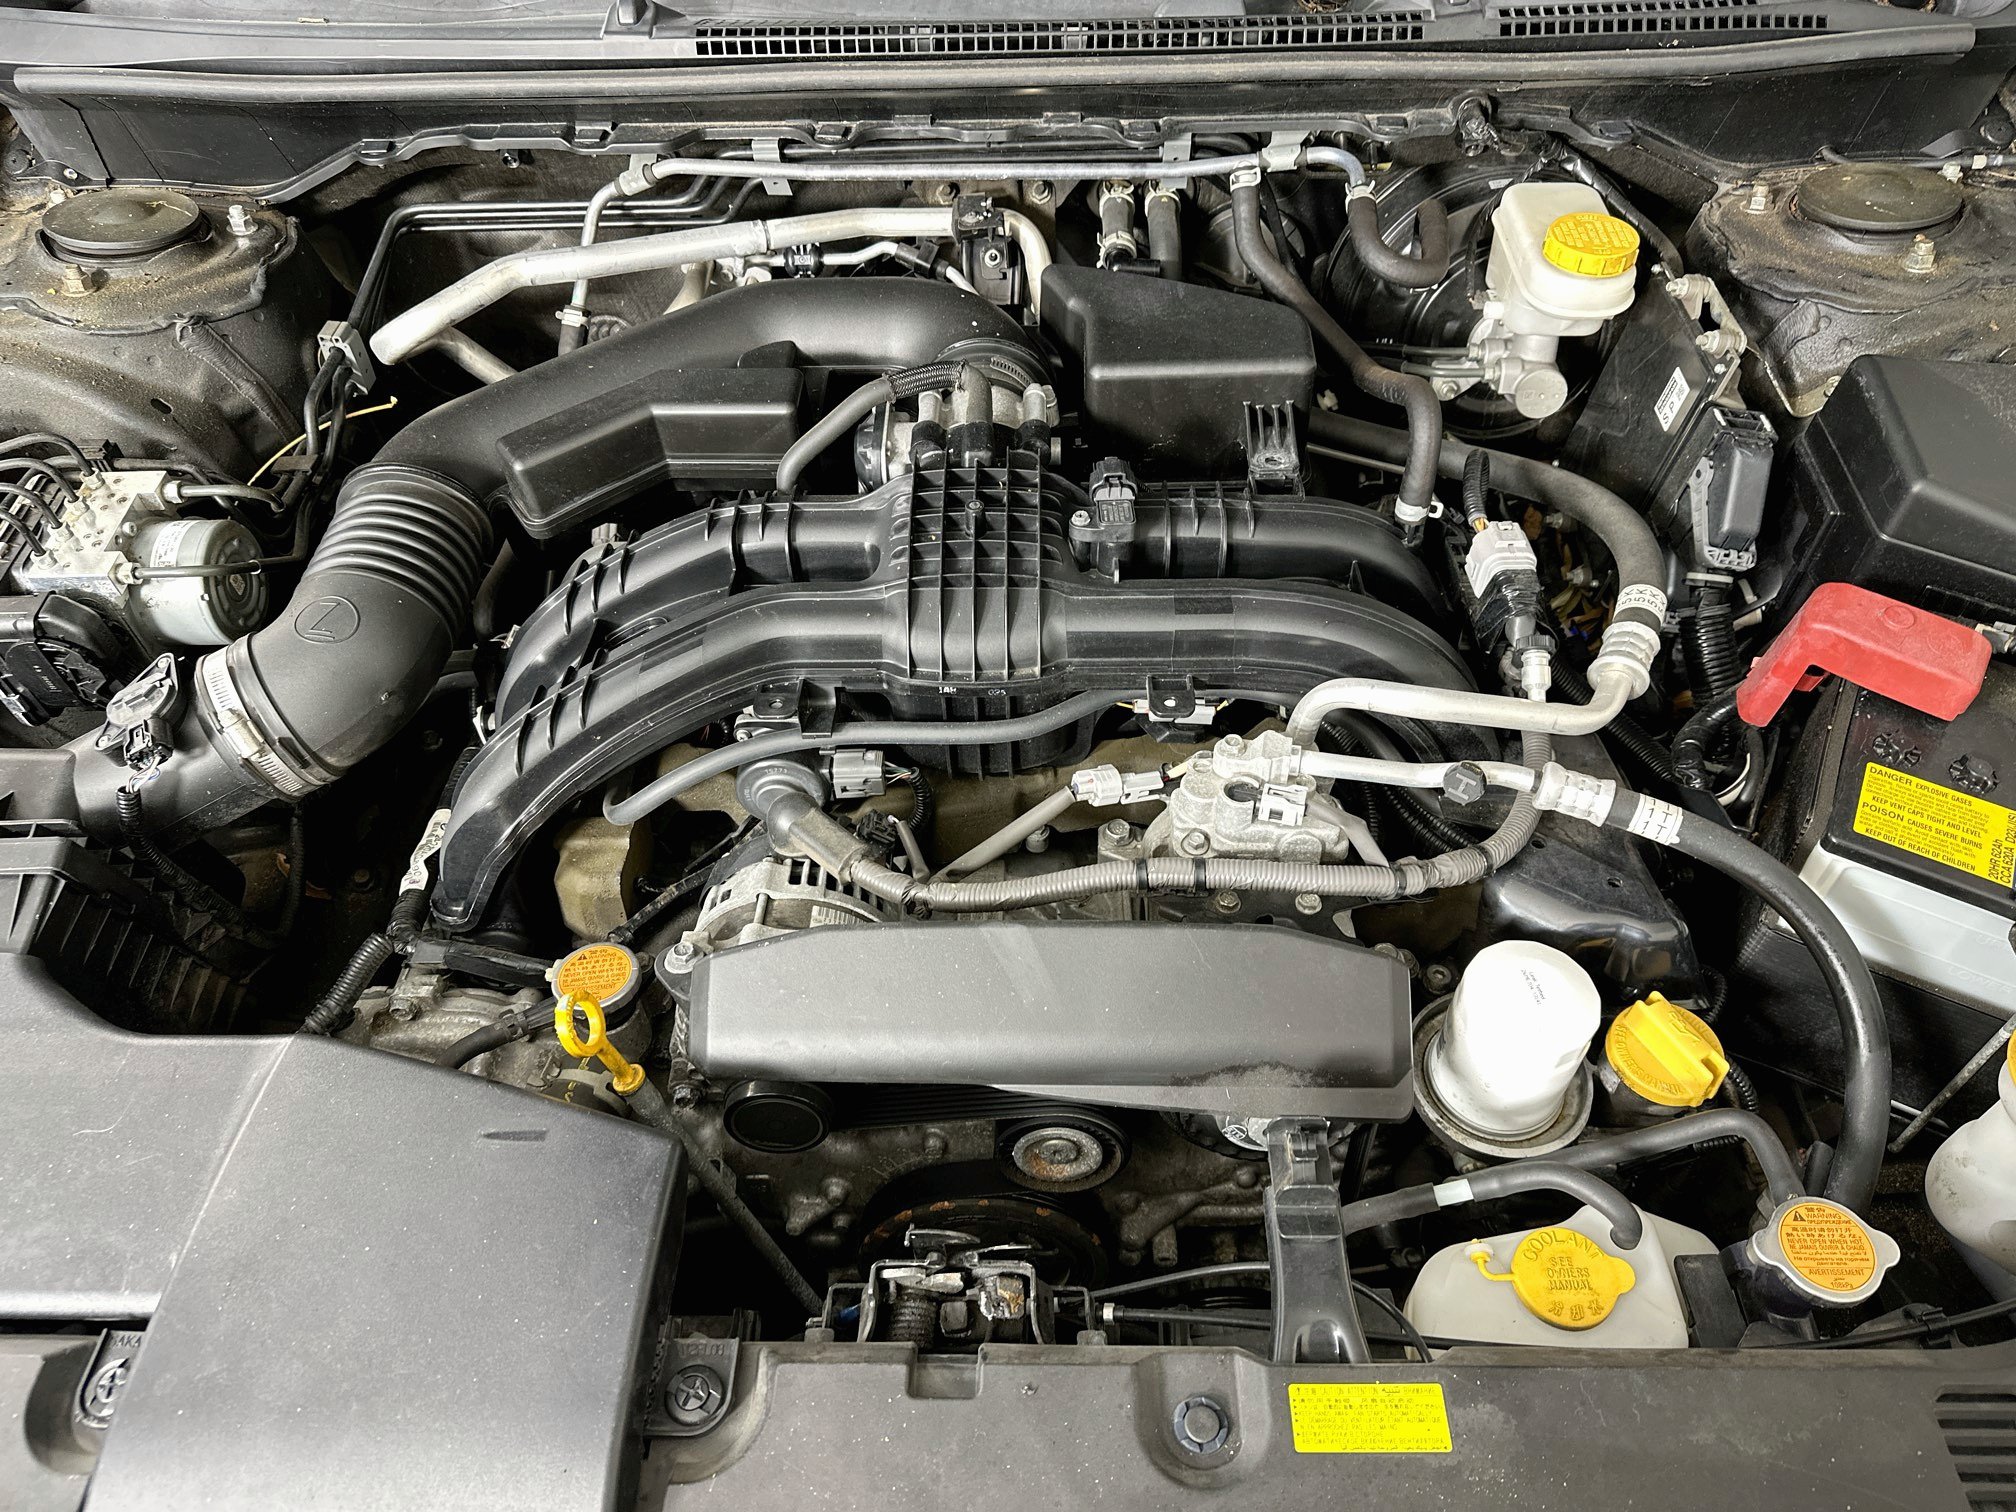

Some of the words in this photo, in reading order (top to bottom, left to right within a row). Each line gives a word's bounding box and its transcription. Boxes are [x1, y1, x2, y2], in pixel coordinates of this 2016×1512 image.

[1869, 766, 1912, 786] DANGER
[1915, 782, 1948, 798] EXPLOSIVE
[1951, 794, 1972, 806] GASES
[1861, 801, 1904, 822] POISON
[1907, 818, 1932, 832] CAUSES
[1934, 827, 1958, 841] SEVERE
[1960, 835, 1982, 850] BURNS
[1871, 795, 1888, 805] KEEP
[1889, 801, 1905, 812] VENT
[1907, 807, 1924, 818] CAPS
[1926, 814, 1945, 826] TIGHT
[1946, 821, 1960, 831] AND
[1961, 826, 1981, 839] LEVEL
[1865, 826, 1881, 838] KEEP
[1882, 833, 1896, 843] OUT
[1897, 838, 1906, 847] OF
[1908, 841, 1930, 856] REACH
[1931, 850, 1940, 859] OF
[1941, 853, 1975, 872] CHILDREN
[2000, 862, 2012, 884] CCA
[1523, 1230, 1605, 1262] COOLANT
[1546, 1267, 1590, 1279] OWNERS
[1548, 1256, 1573, 1267] SEE
[1808, 1268, 1865, 1276] AVERTISSEMENT
[1548, 1279, 1594, 1291] MANUAL
